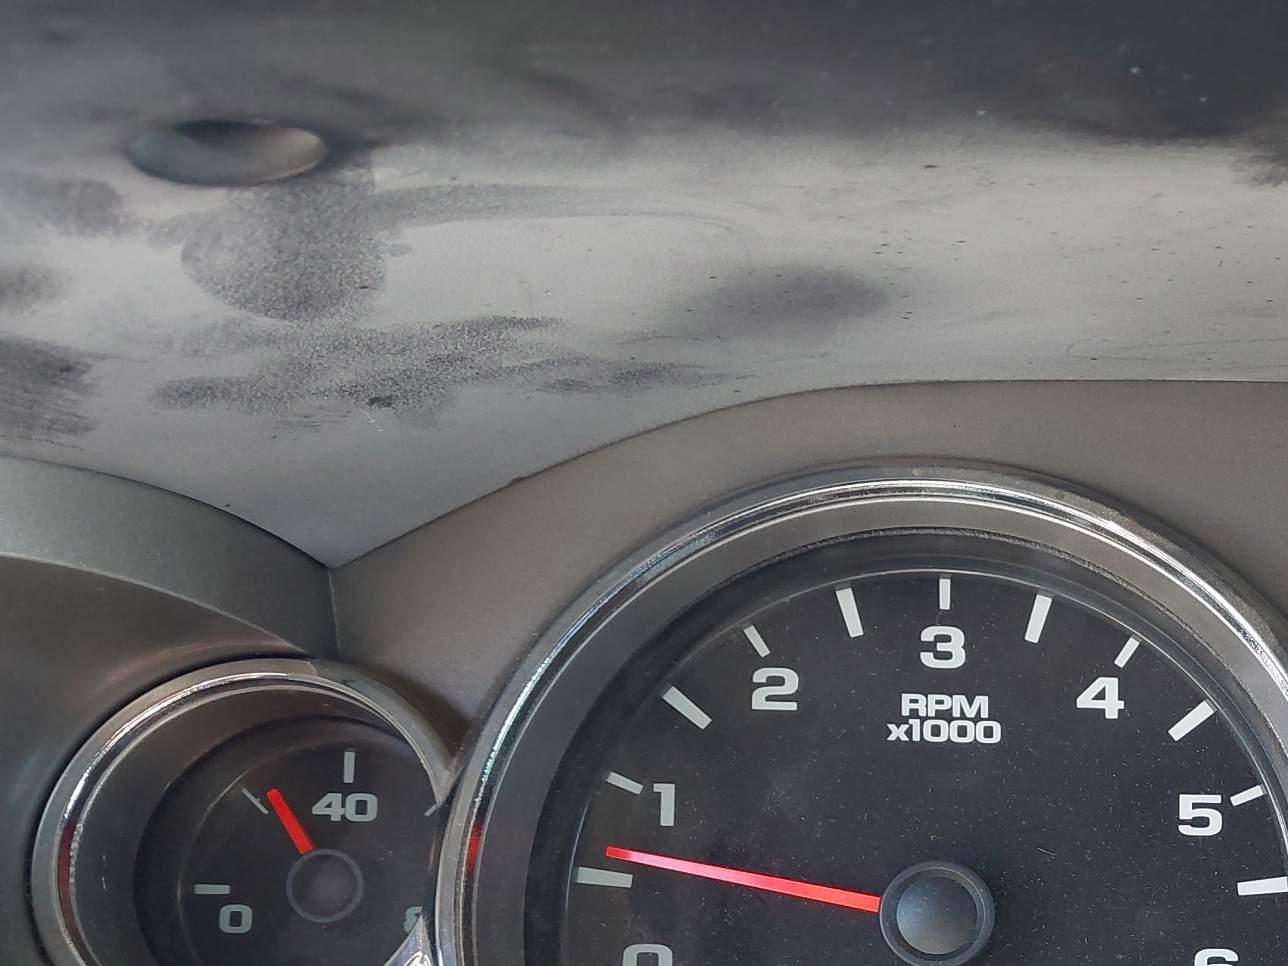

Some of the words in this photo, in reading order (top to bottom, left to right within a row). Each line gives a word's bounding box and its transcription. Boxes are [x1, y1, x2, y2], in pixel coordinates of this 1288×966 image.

[920, 626, 966, 668] 3
[751, 667, 799, 711] 2
[901, 694, 989, 717] RPM
[1076, 677, 1125, 720] 4
[887, 719, 1001, 744] x1000
[311, 793, 378, 822] 40
[653, 783, 676, 827] 1
[1178, 794, 1222, 836] 5
[218, 904, 253, 934] 0
